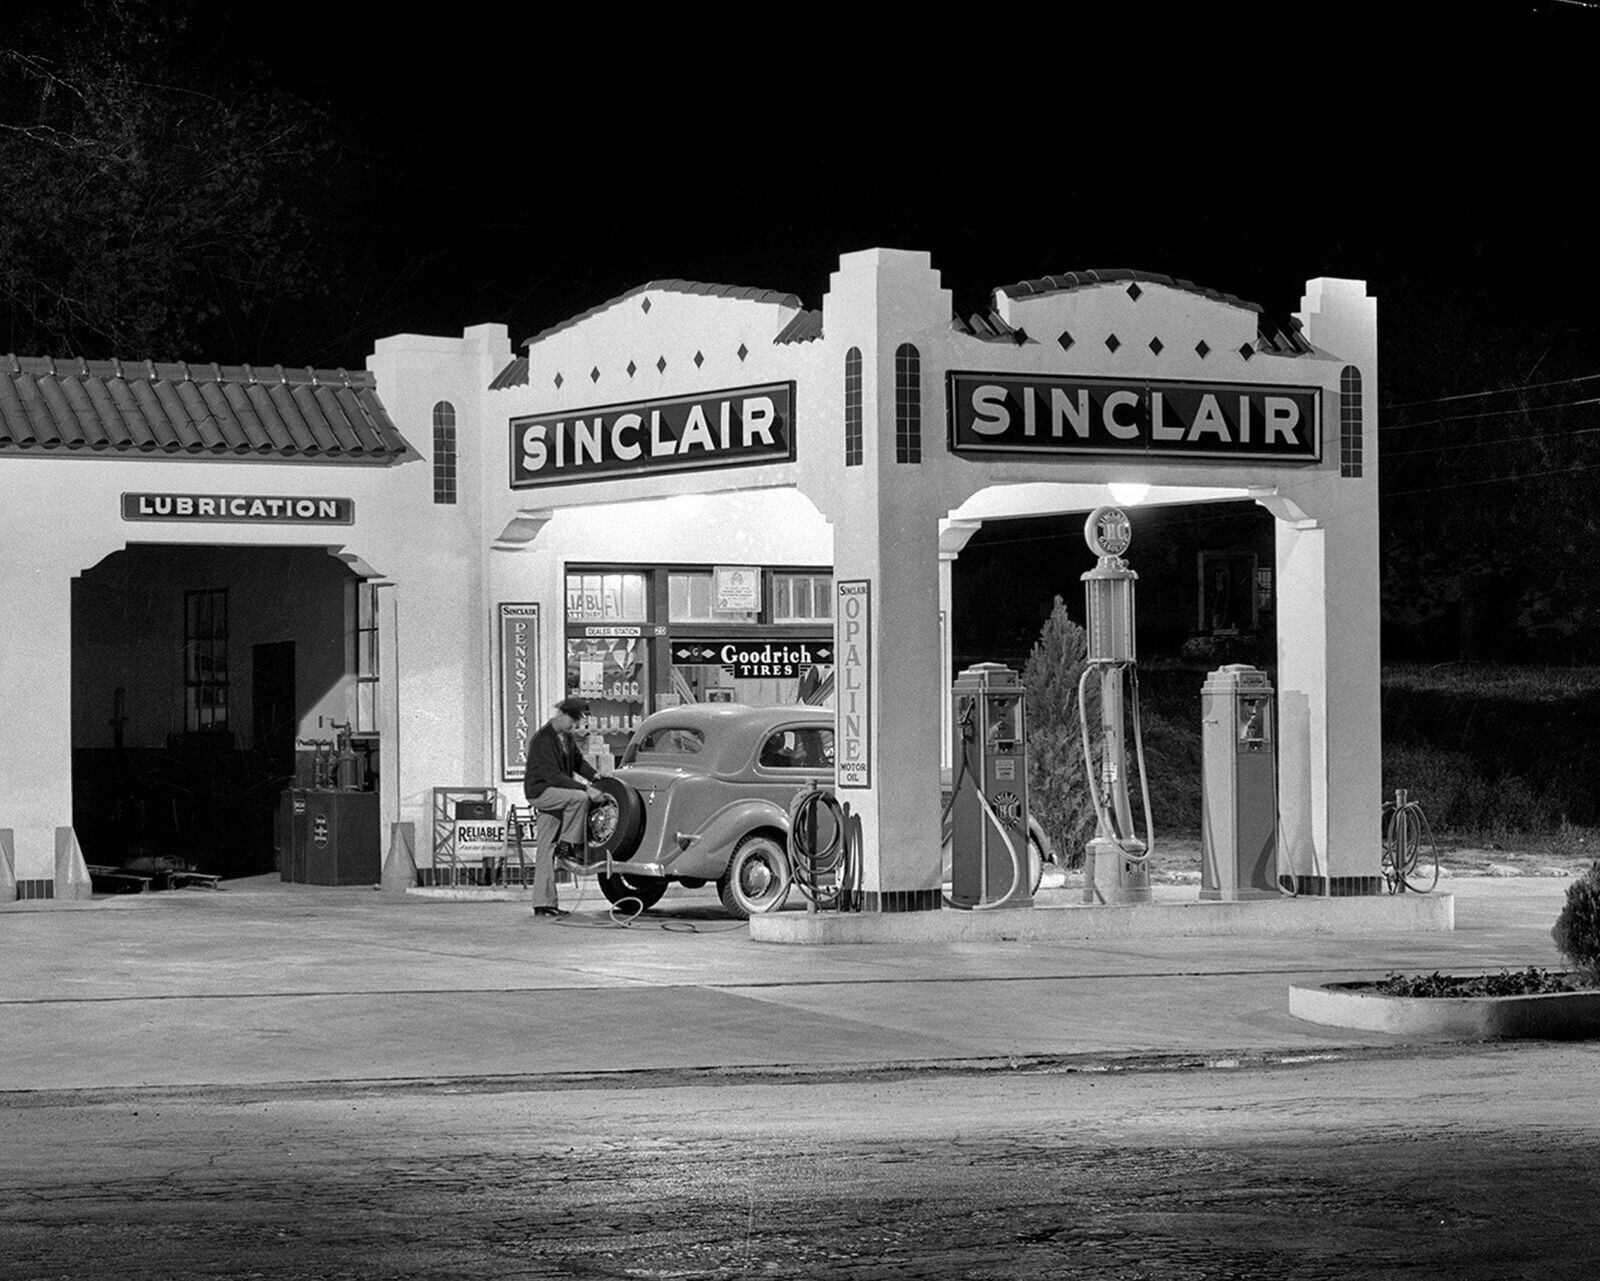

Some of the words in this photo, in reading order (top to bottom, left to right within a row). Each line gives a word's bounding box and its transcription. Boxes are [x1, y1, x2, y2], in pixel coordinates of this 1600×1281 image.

[971, 385, 1300, 445] SINCLAIR
[522, 396, 775, 471] SINCLAIR
[139, 496, 338, 518] LUBRICATION
[503, 606, 537, 615] SINCLAIR
[720, 644, 812, 664] Goodrich
[740, 665, 793, 676] TIRES
[845, 597, 861, 761] OPALINE
[514, 622, 529, 763] PENNSYLVANIA
[840, 762, 866, 772] MOTOR
[846, 773, 860, 782] OIL
[458, 827, 505, 842] RELIABLE
